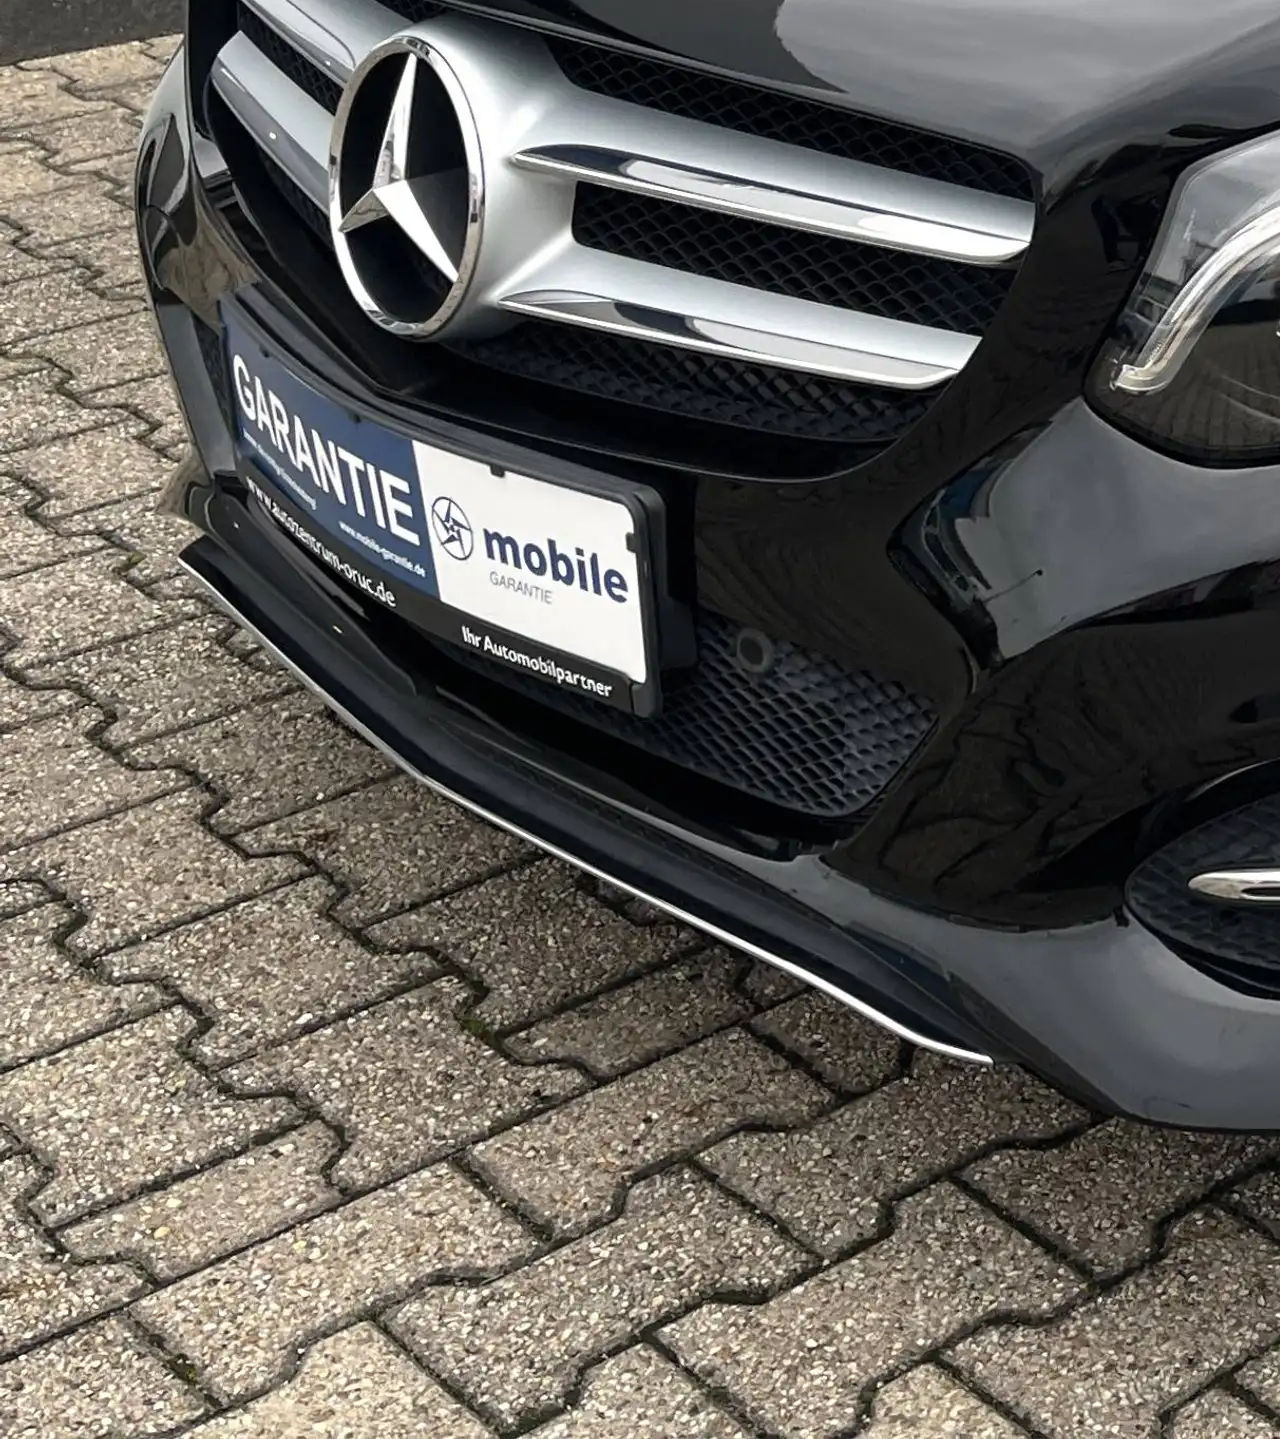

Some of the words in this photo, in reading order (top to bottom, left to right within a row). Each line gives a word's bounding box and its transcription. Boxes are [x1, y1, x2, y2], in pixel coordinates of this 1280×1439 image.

[233, 353, 421, 548] GARANTIE
[248, 477, 397, 609] www.autozentrum-oruc.de
[484, 525, 629, 604] mobile
[490, 570, 554, 605] GARANTIE
[461, 624, 481, 648] Ihr
[484, 635, 613, 698] Automobilpartner
